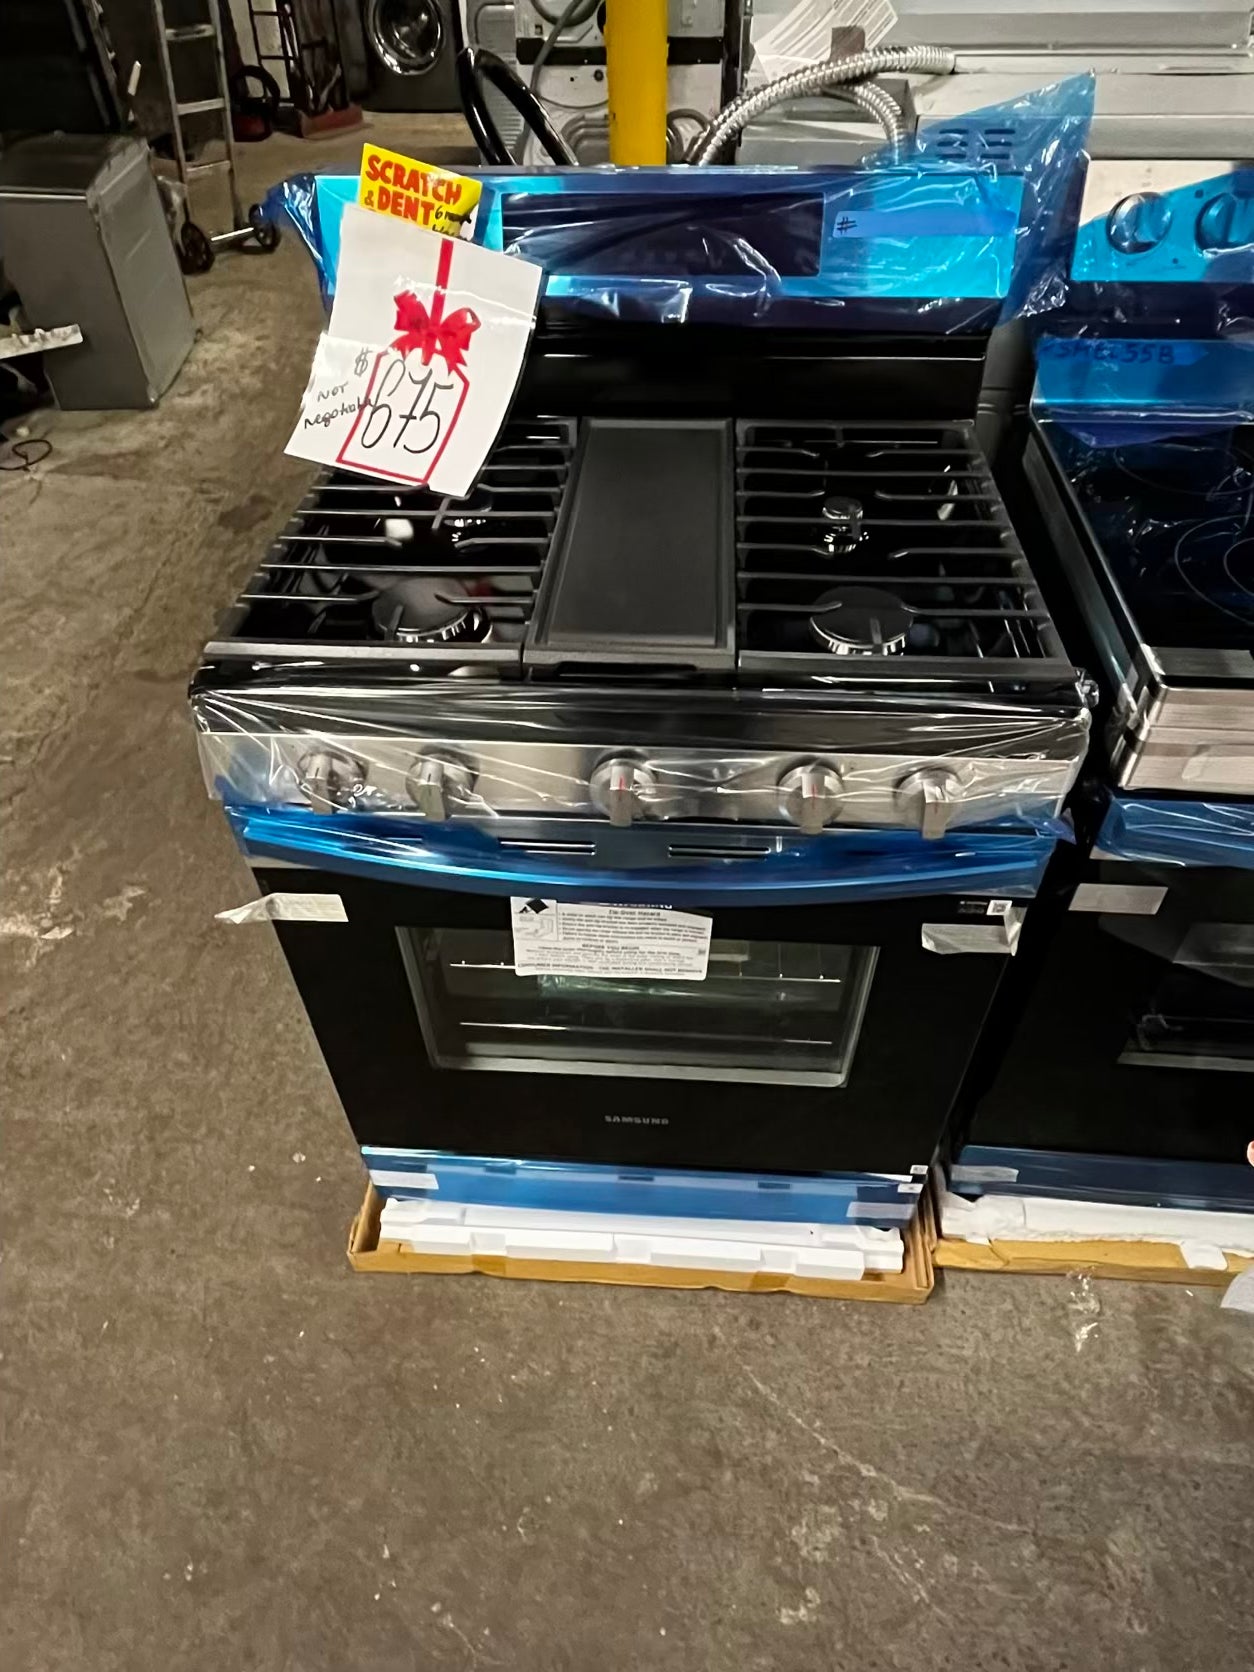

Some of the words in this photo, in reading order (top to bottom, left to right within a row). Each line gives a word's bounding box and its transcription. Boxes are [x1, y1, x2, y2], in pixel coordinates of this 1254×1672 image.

[365, 154, 462, 205] SCRATCH
[364, 189, 375, 208] &
[377, 185, 435, 226] DENT
[360, 358, 455, 454] 675
[604, 1115, 669, 1125] SAMSUNG
